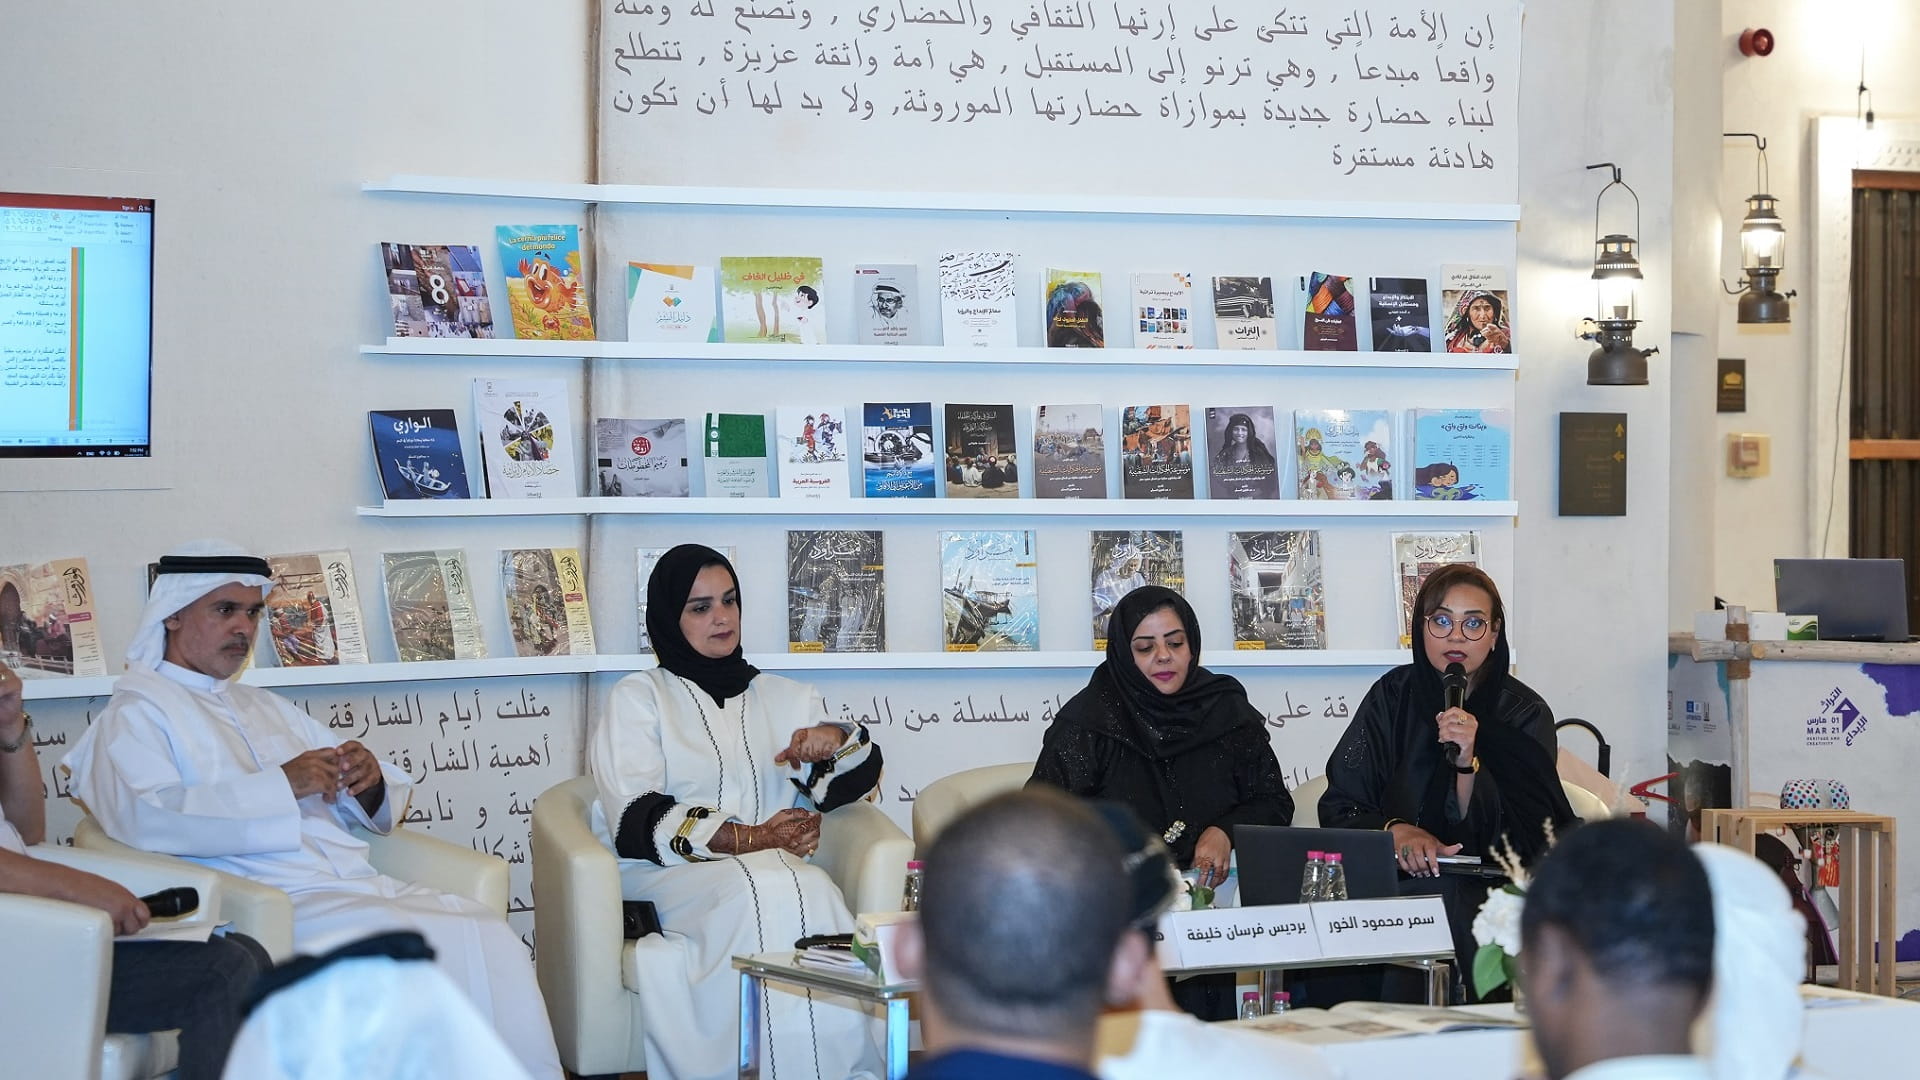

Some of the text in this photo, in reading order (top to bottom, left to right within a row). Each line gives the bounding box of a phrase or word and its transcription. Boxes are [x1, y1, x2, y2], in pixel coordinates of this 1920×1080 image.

[734, 0, 812, 36] وتصنع
[858, 0, 993, 36] والحضاري
[1010, 0, 1096, 42] الثقافي
[1113, 1, 1177, 41] إرثها
[1194, 4, 1239, 42] على
[1256, 7, 1309, 44] تتكئ
[1325, 9, 1373, 50] التي
[1389, 9, 1448, 42] الأمة
[1464, 13, 1495, 51] إن
[614, 31, 682, 77] تتطلع
[723, 39, 799, 74] عزيزة
[814, 37, 878, 77] واثقة
[893, 38, 935, 70] أمة
[948, 49, 985, 84] هي
[1024, 43, 1134, 79] المستقبل
[1147, 46, 1187, 85] إلى
[1202, 56, 1252, 86] ترنو
[1266, 58, 1316, 93] وهي
[613, 76, 679, 115] تكون
[696, 77, 729, 115] أن
[746, 79, 783, 115] لها
[800, 91, 823, 117] بد
[841, 81, 874, 121] ولا
[1030, 86, 1143, 126] حضارتها
[1159, 90, 1247, 129] بموازاة
[1263, 98, 1331, 130] جديدة
[1348, 95, 1432, 133] حضارة
[1447, 98, 1494, 133] لبناء
[1332, 141, 1494, 176] هادئة مستقرة
[429, 274, 449, 305] 8
[394, 416, 432, 435] الواري
[328, 687, 551, 738] مثلت أيام الشارقة
[952, 694, 1030, 723] سلسلة
[1267, 690, 1311, 728] على
[1820, 686, 1843, 714] التراث
[904, 707, 941, 733] من
[1806, 716, 1840, 726] 01 مارس
[1845, 715, 1868, 747] الإبداع
[489, 733, 551, 777] أهمية
[475, 806, 488, 830] و
[1187, 920, 1306, 944] برديس فرسان خليفة
[1328, 914, 1435, 934] سمر محمود الخور
